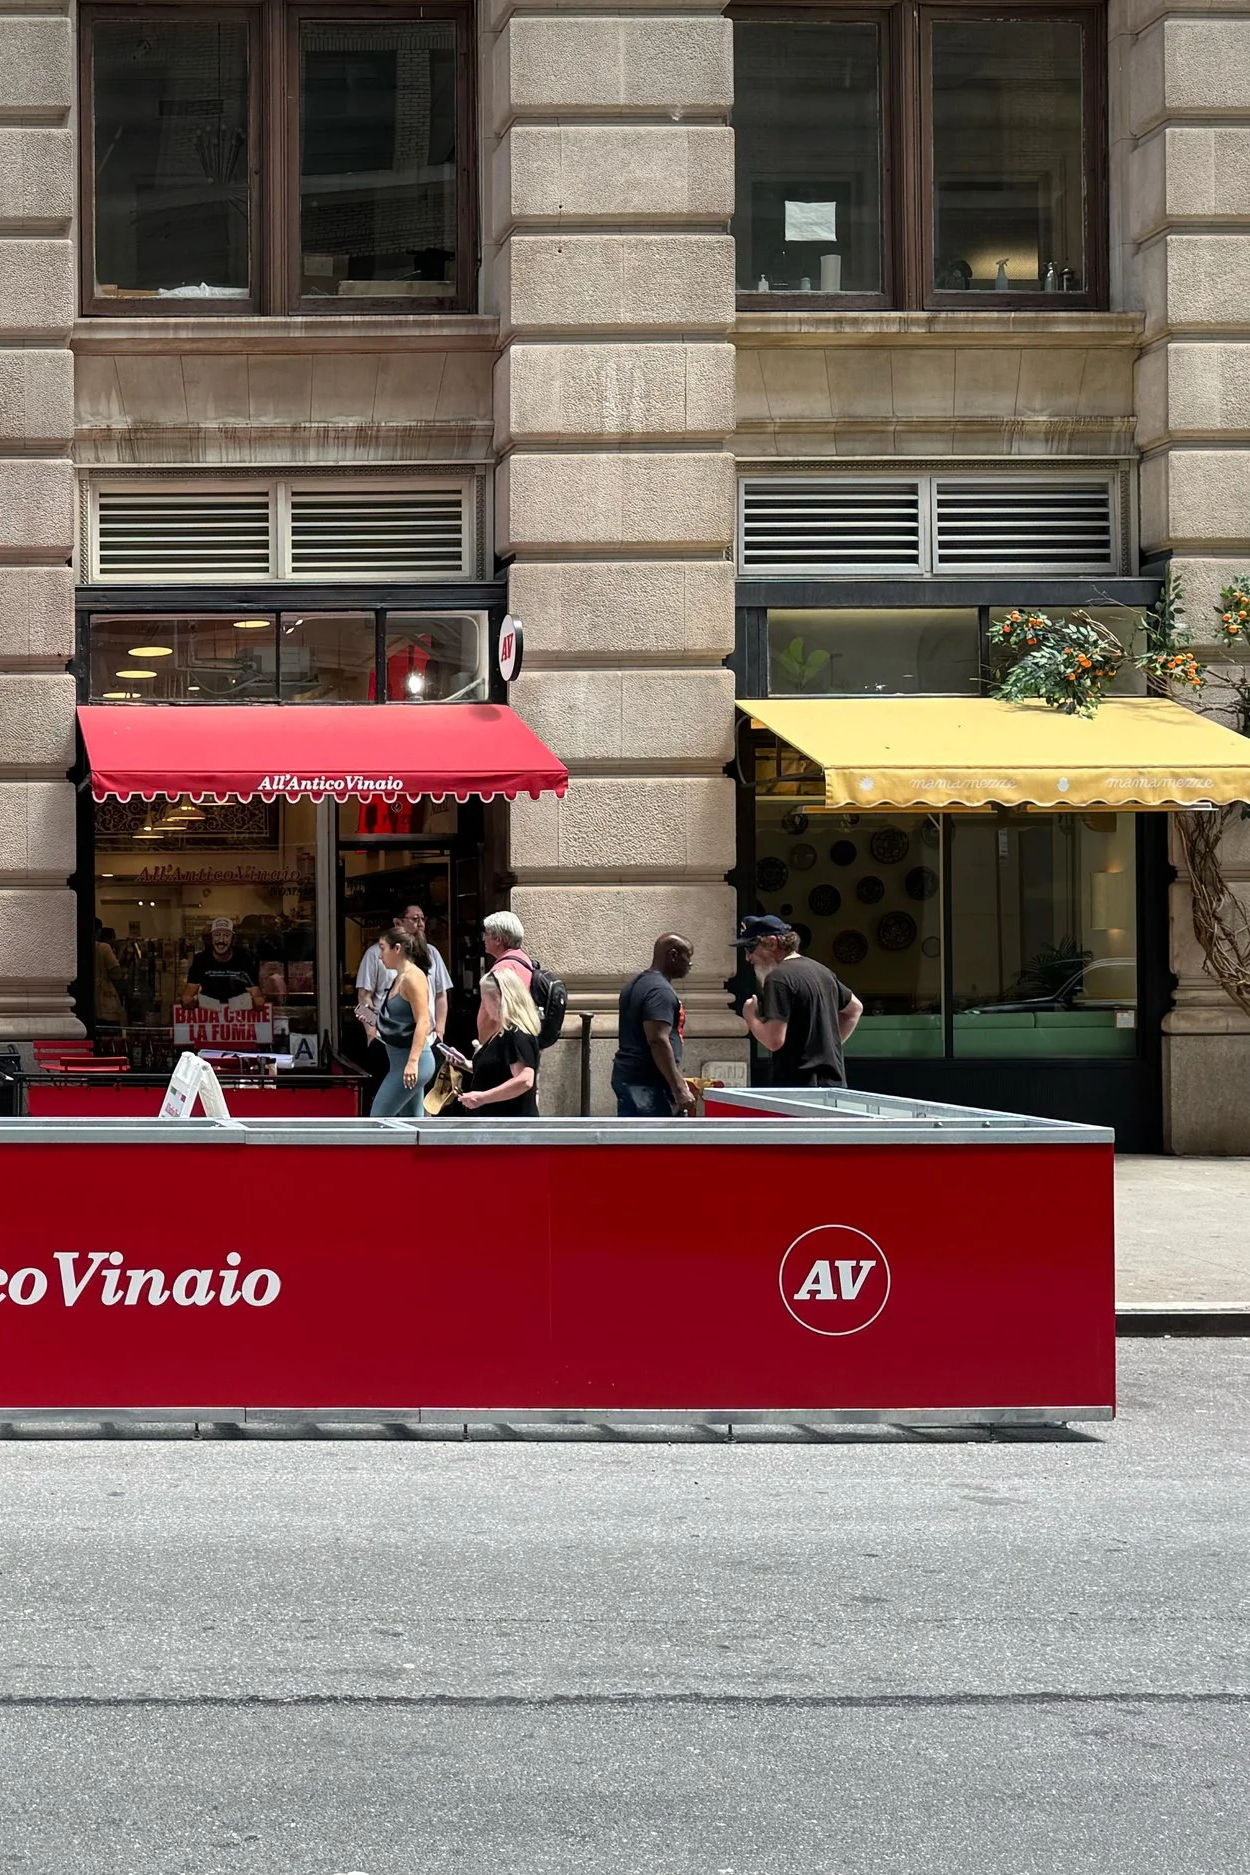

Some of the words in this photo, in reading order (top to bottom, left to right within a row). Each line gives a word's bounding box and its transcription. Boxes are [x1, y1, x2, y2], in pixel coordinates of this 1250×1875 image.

[500, 632, 514, 662] AV
[909, 777, 1018, 790] mamamezze
[1105, 777, 1214, 790] mamamezze
[189, 1024, 207, 1041] LA
[212, 1024, 257, 1041] FUMA
[295, 1038, 313, 1060] A
[793, 1260, 876, 1300] AV
